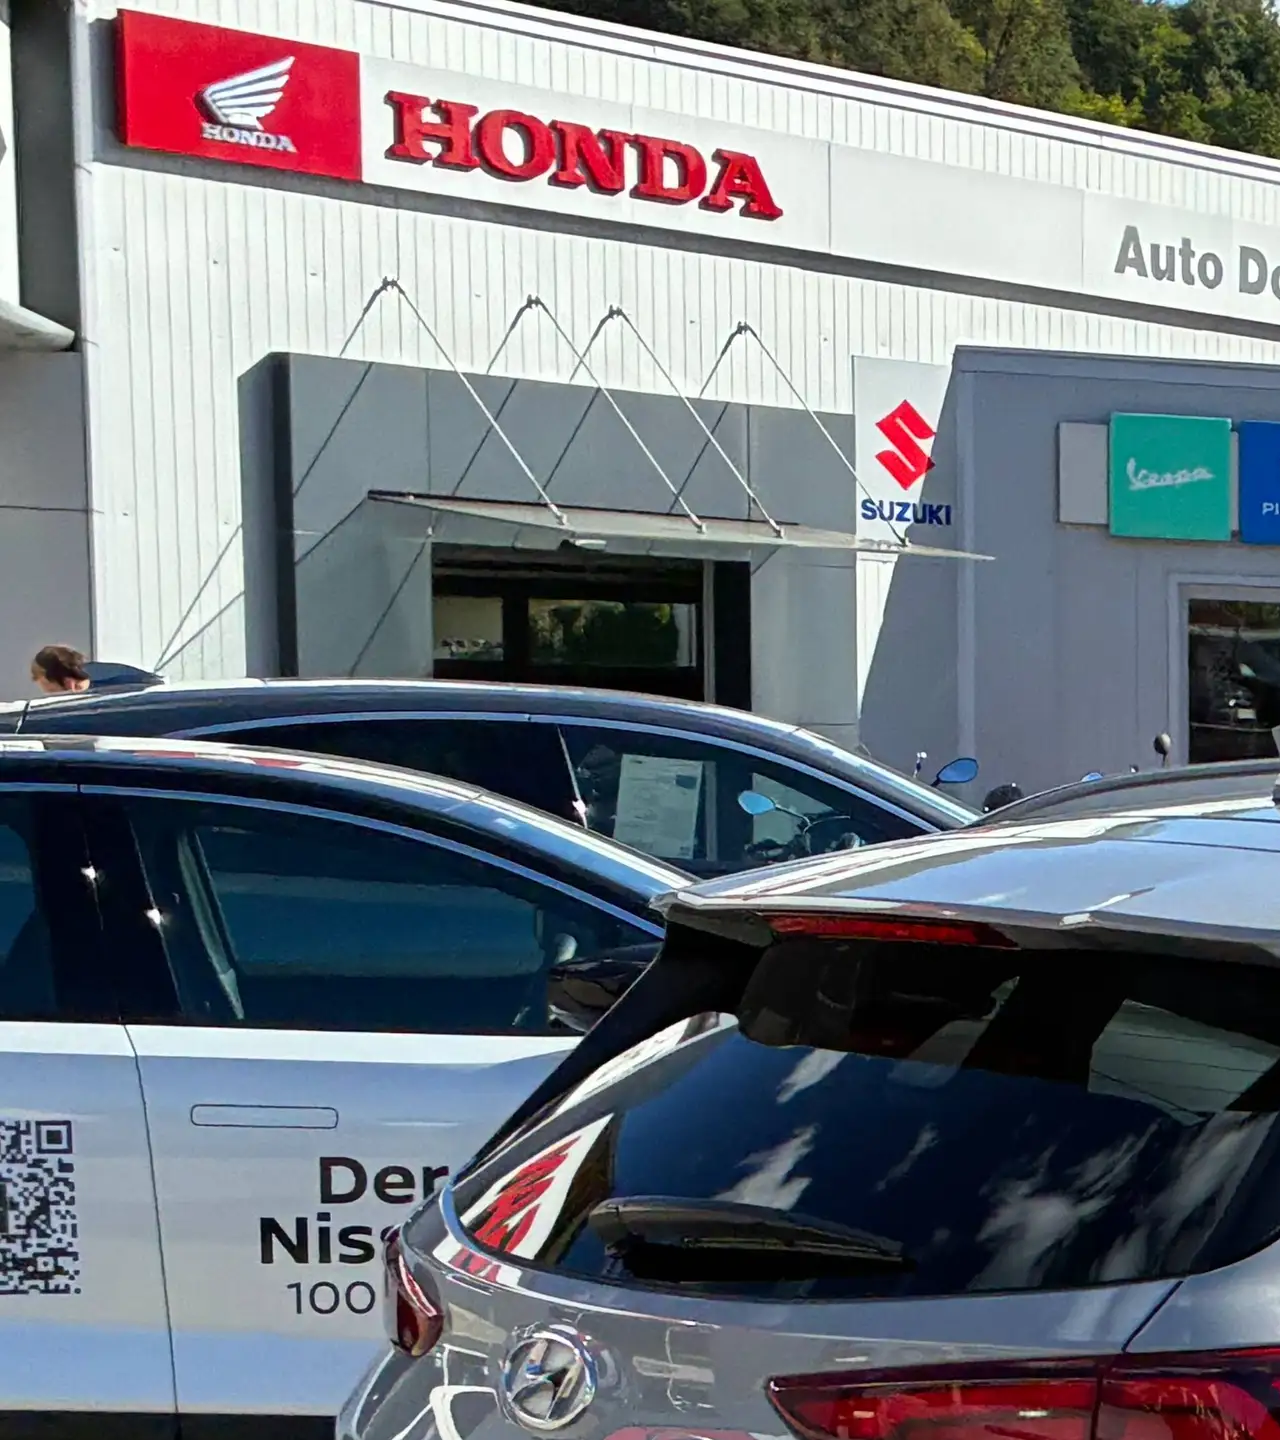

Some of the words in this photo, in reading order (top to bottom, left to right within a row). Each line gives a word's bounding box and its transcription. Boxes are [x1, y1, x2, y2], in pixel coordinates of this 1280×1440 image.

[202, 122, 297, 153] HONDA
[384, 90, 783, 221] HONDA
[1114, 224, 1223, 290] Auto
[861, 499, 953, 526] SUZUKI
[319, 1156, 450, 1204] Der
[286, 1281, 376, 1315] 100
